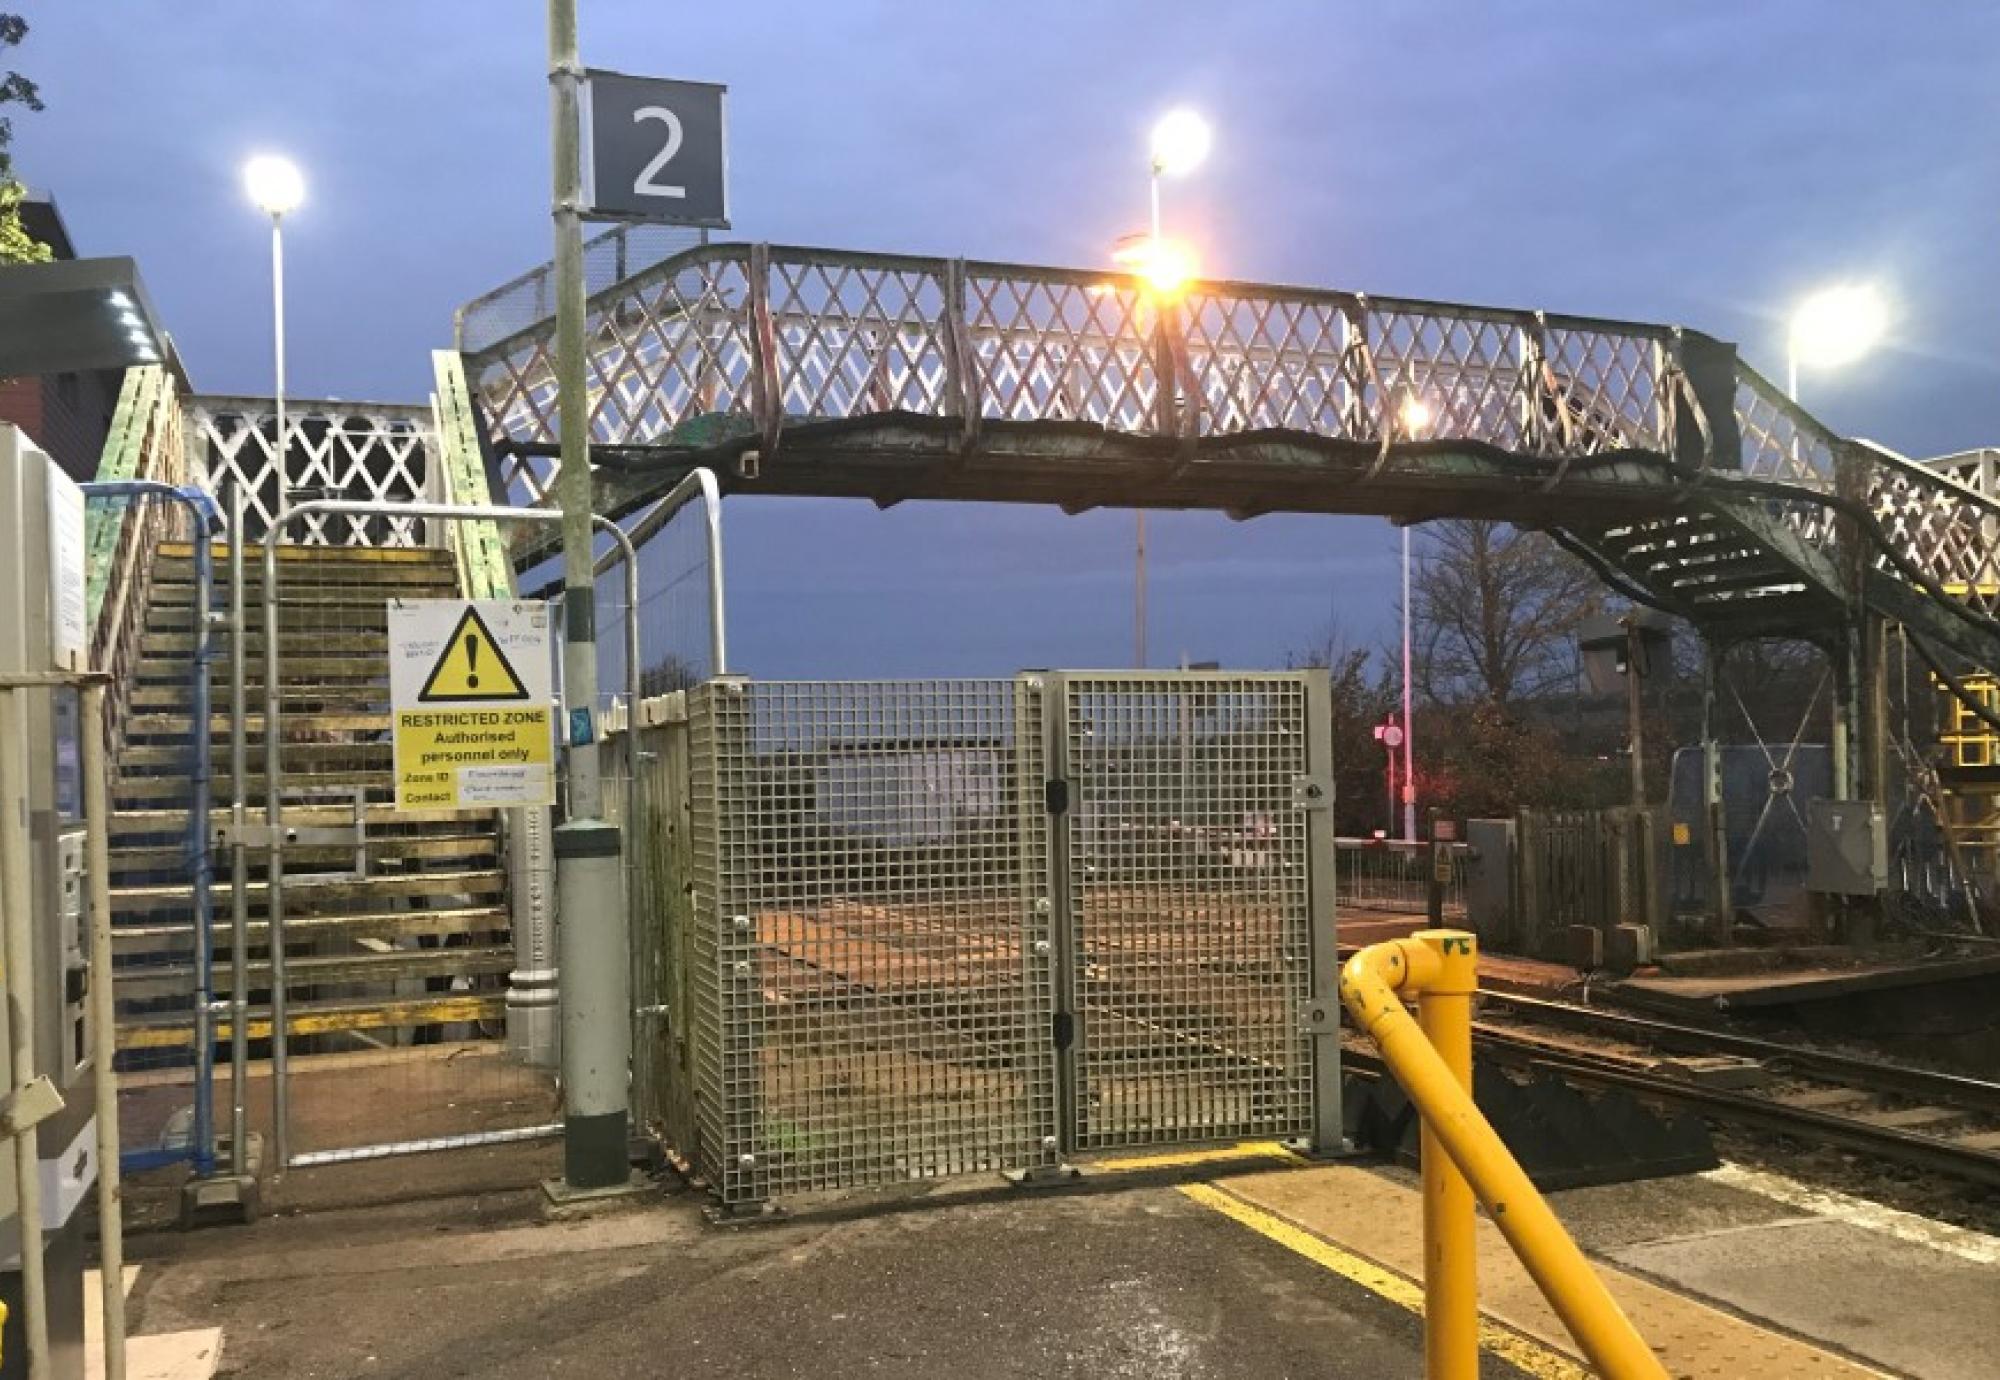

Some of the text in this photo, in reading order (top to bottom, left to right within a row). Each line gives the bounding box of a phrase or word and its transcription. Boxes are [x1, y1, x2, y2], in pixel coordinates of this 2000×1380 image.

[633, 106, 686, 199] 2
[401, 711, 545, 728] RESTRICTED ZONE
[434, 730, 516, 744] Authorised
[421, 747, 529, 766] personnel only
[403, 772, 433, 783] Zone
[404, 792, 451, 804] Contact
